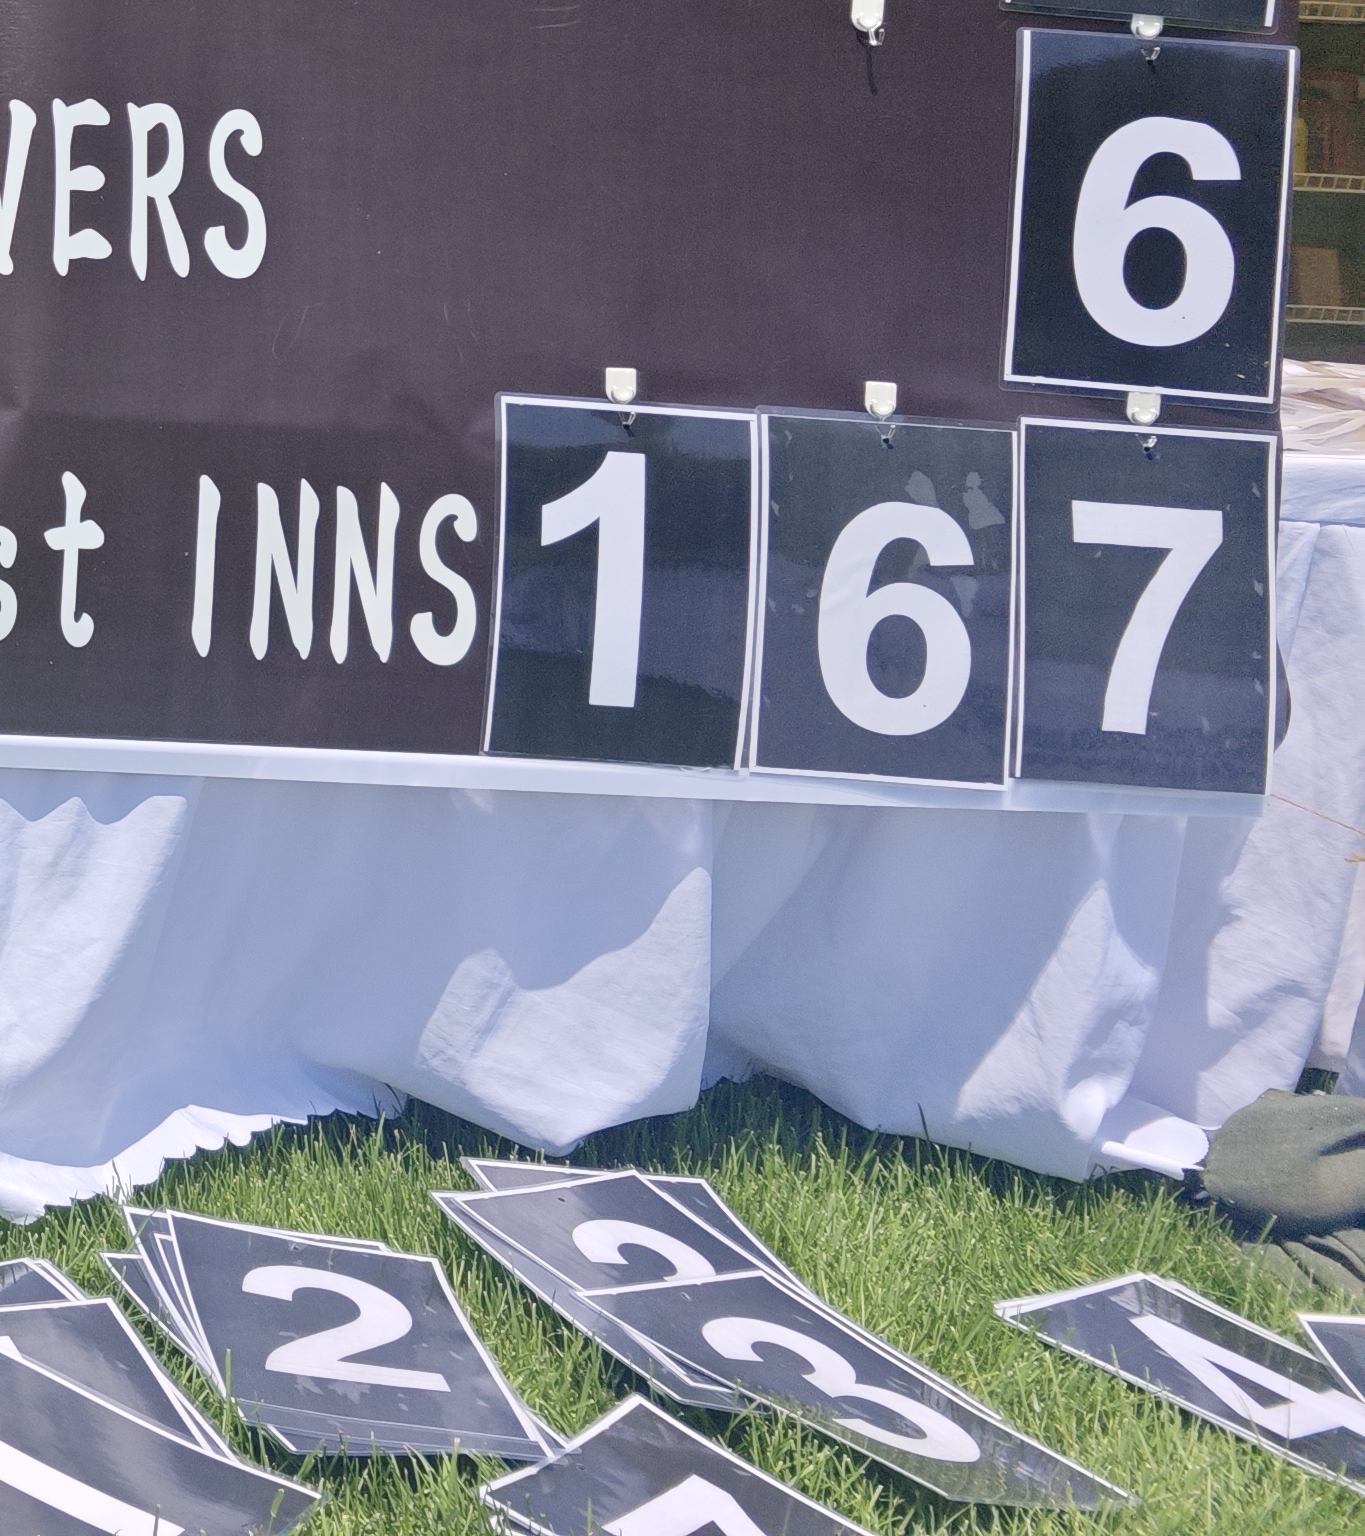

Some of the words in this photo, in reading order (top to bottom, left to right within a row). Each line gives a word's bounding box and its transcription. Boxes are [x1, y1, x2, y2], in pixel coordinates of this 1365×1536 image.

[1072, 115, 1243, 348] 6
[190, 473, 478, 666] INNS
[241, 1265, 453, 1393] 2
[701, 1315, 982, 1465] 3
